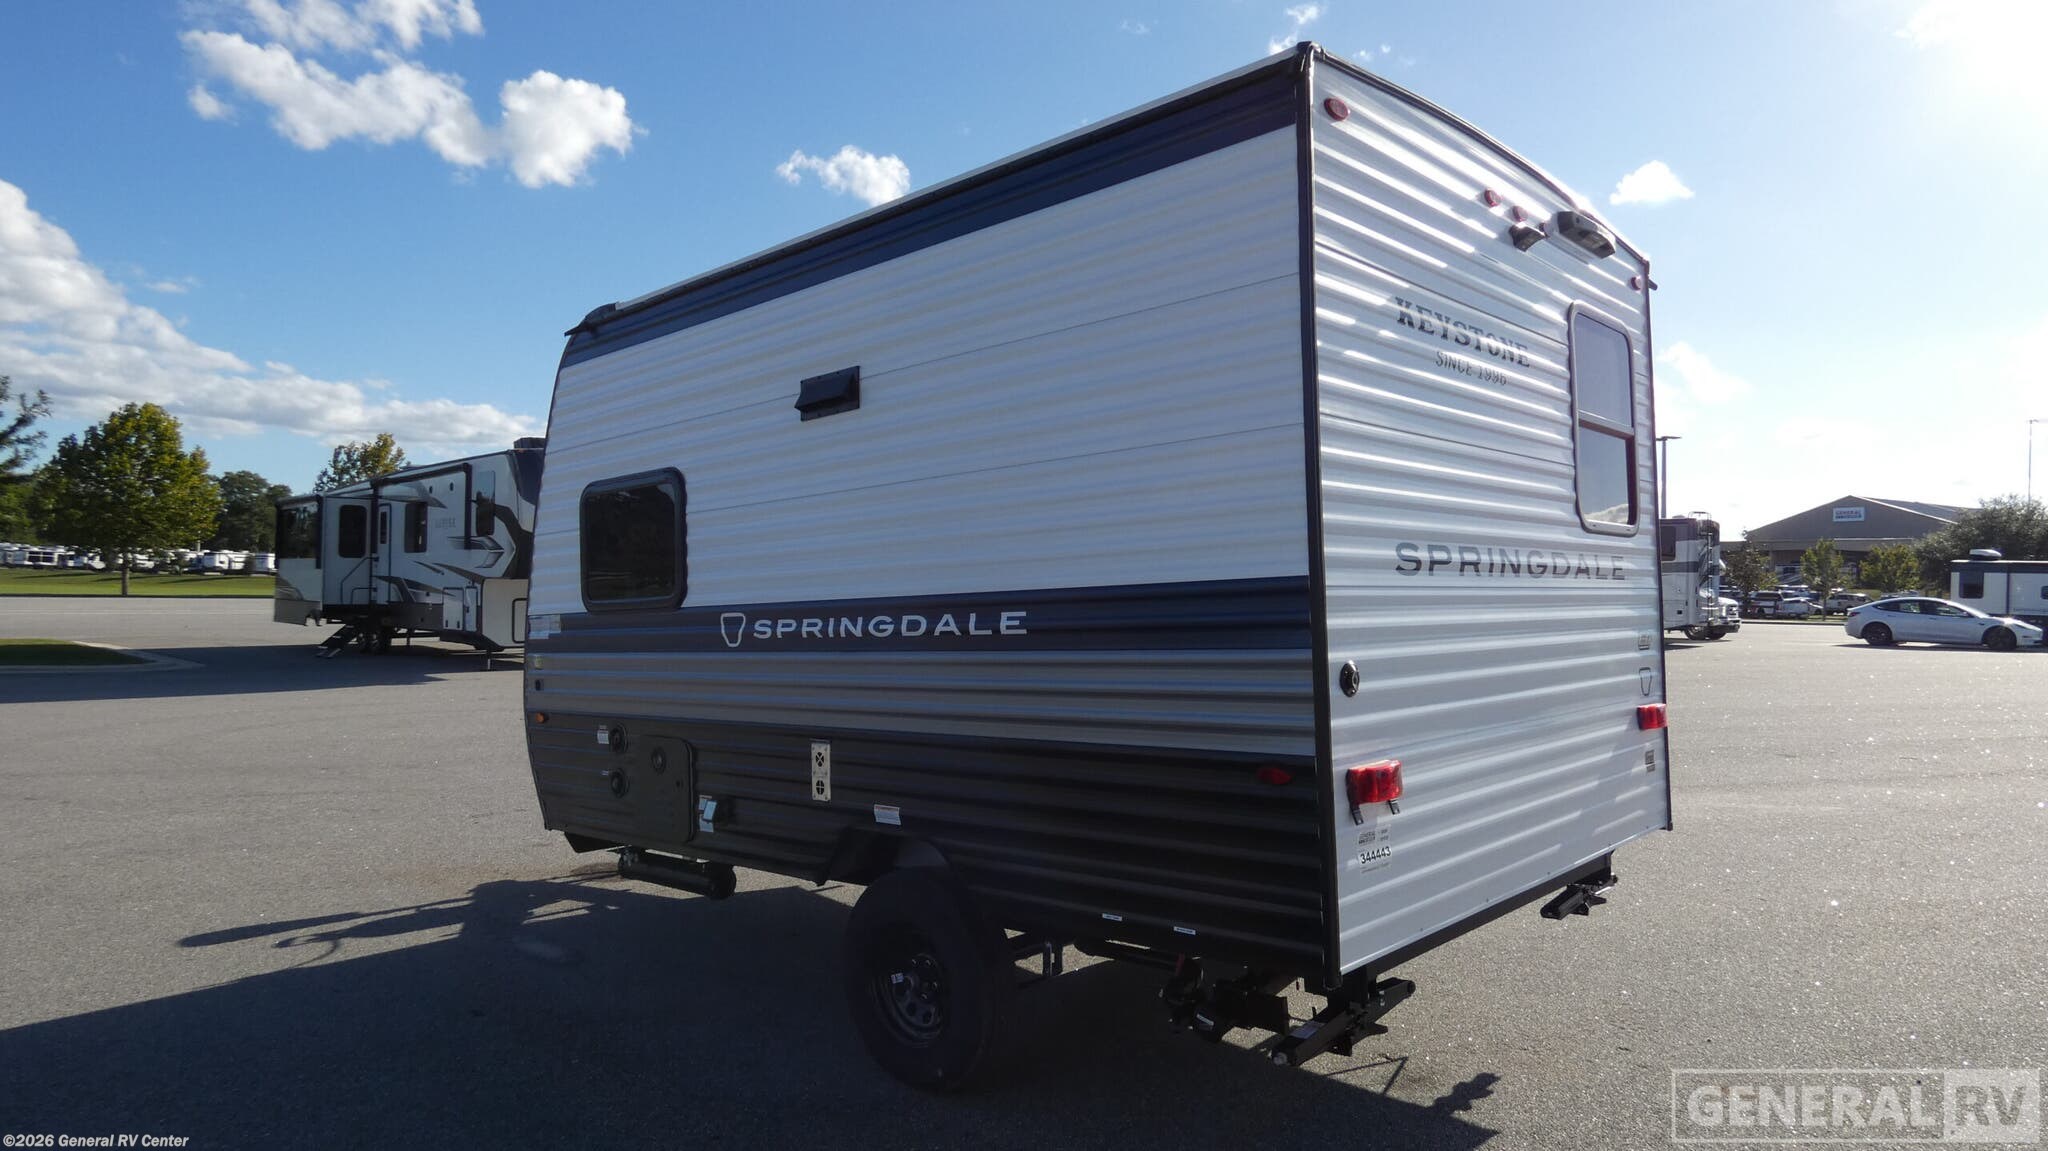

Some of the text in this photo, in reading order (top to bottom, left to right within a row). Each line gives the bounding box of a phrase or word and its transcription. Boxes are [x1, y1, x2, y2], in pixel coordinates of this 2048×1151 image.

[1395, 297, 1530, 367] KEYSTONE
[1435, 351, 1507, 386] SINCE 1996
[1395, 542, 1626, 580] SPRINGDALE
[753, 612, 1028, 639] SPRINGDALE
[1360, 846, 1391, 864] 344443
